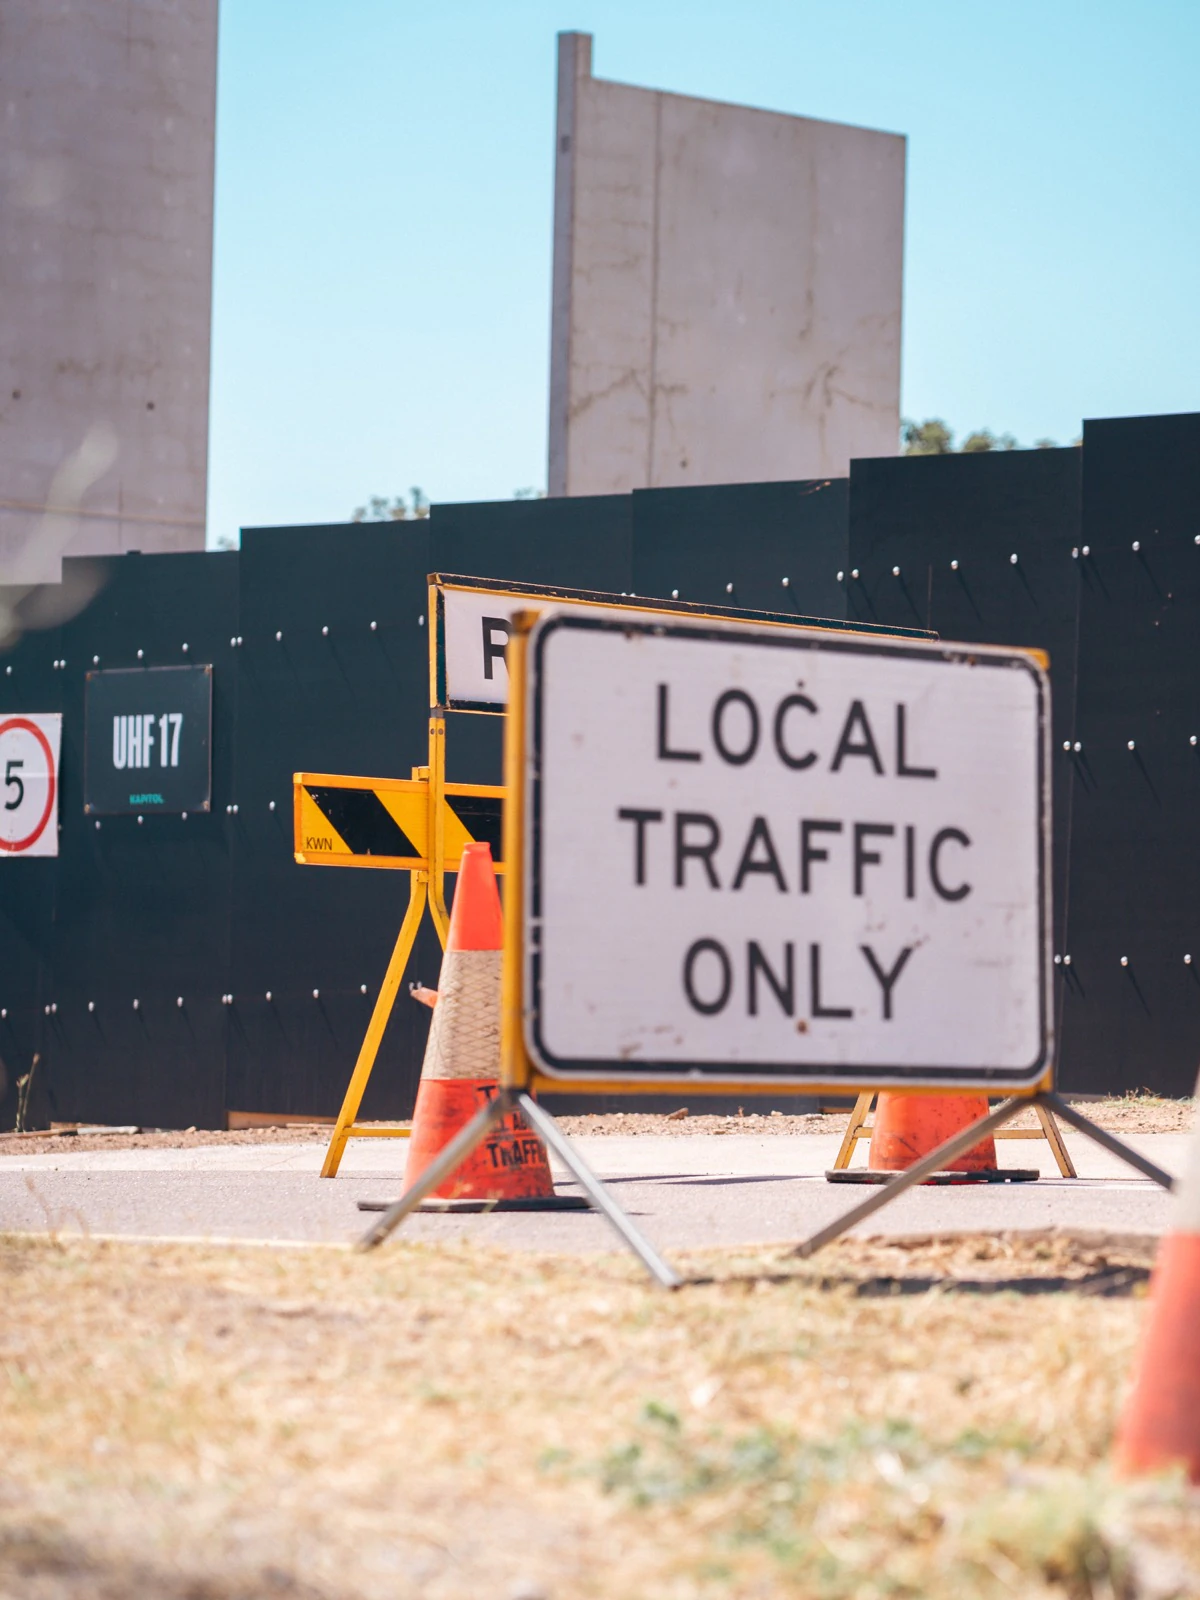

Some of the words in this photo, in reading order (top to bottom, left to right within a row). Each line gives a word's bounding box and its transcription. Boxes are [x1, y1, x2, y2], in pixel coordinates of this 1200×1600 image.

[113, 714, 155, 770] UHF
[159, 713, 183, 768] 17
[656, 682, 938, 780] LOCAL
[4, 759, 25, 811] 5
[306, 837, 333, 851] KWN
[617, 806, 973, 902] TRAFFIC
[682, 937, 914, 1022] ONLY
